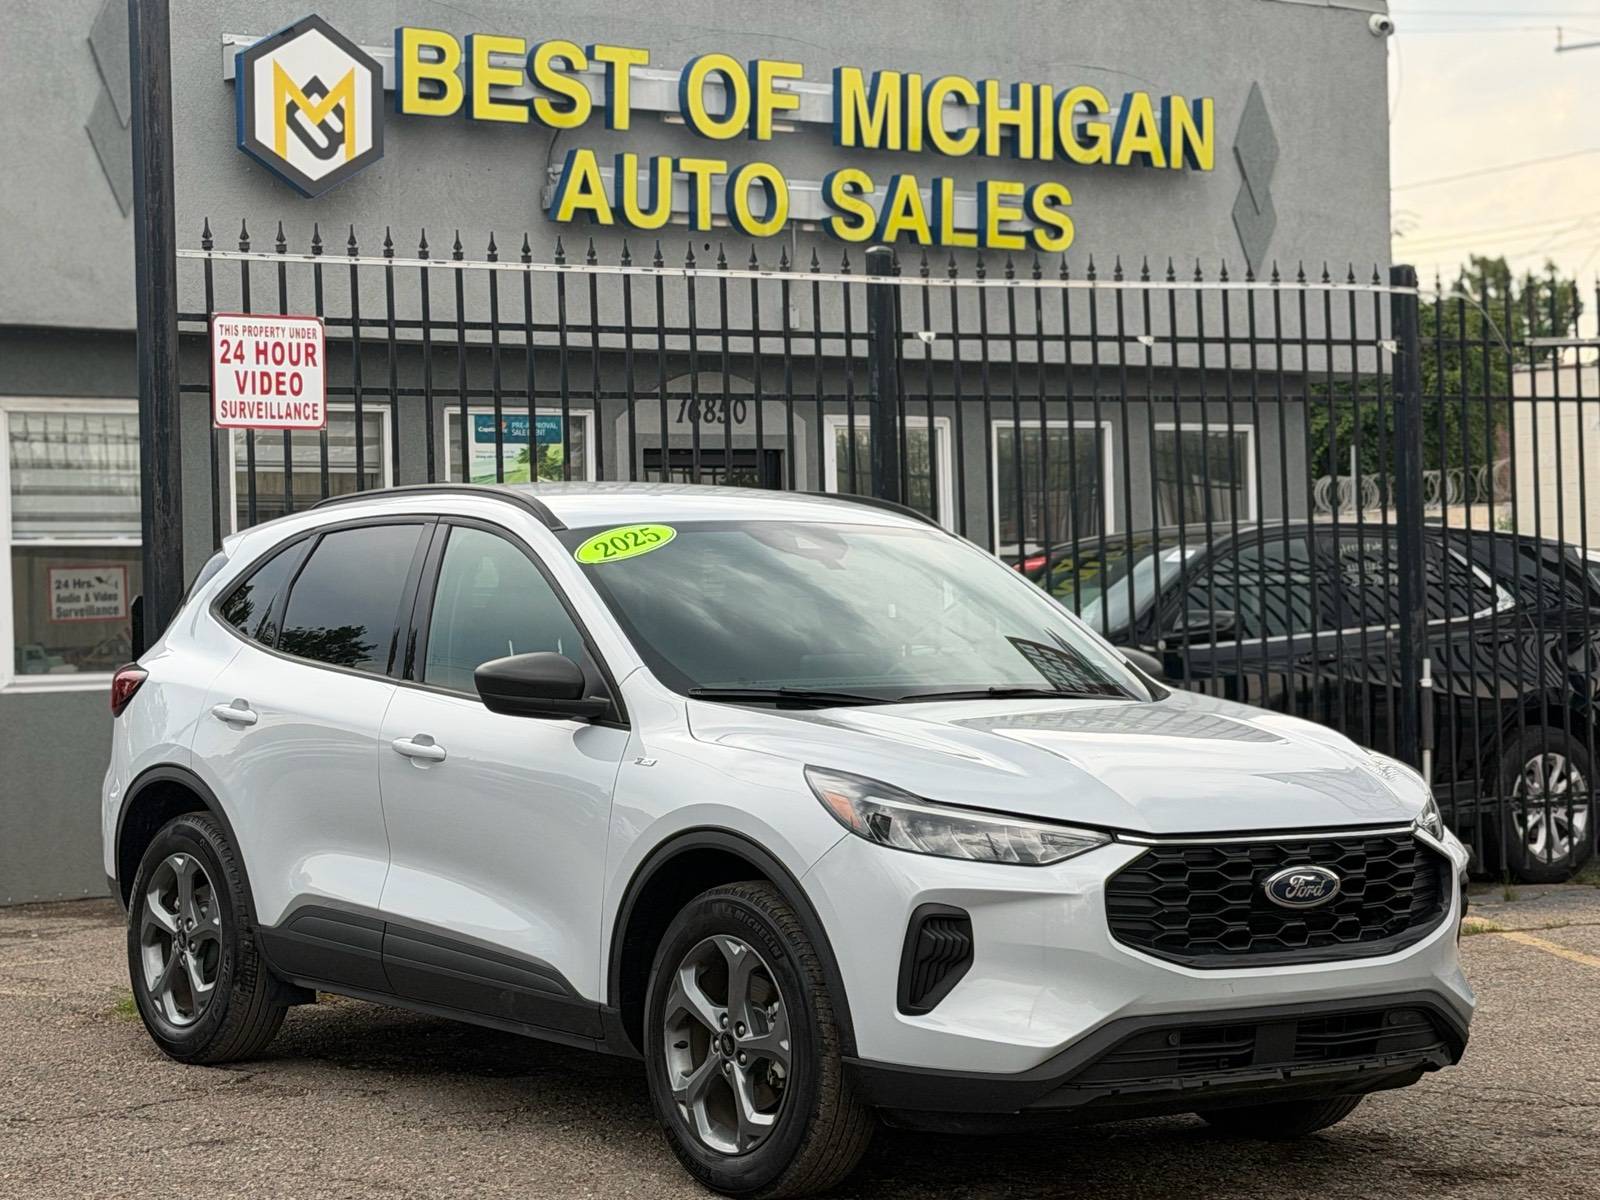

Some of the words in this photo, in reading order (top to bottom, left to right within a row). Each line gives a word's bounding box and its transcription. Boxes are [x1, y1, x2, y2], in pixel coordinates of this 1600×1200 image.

[398, 28, 648, 129] BEST
[683, 55, 802, 141] OF
[837, 68, 1215, 171] MICHIGAN
[555, 149, 789, 236] AUTO
[828, 167, 1074, 252] SALES
[219, 324, 239, 337] THIS
[242, 325, 286, 338] PROPERTY
[289, 327, 317, 340] UNDER
[220, 339, 245, 364] 24
[255, 341, 317, 367] HOUR
[234, 370, 303, 397] VIDEO
[220, 400, 319, 420] SURVEILLANCE
[594, 528, 661, 558] 2025
[55, 579, 69, 589] 24
[1285, 875, 1327, 898] Ford
[734, 908, 786, 960] MICHELIN
